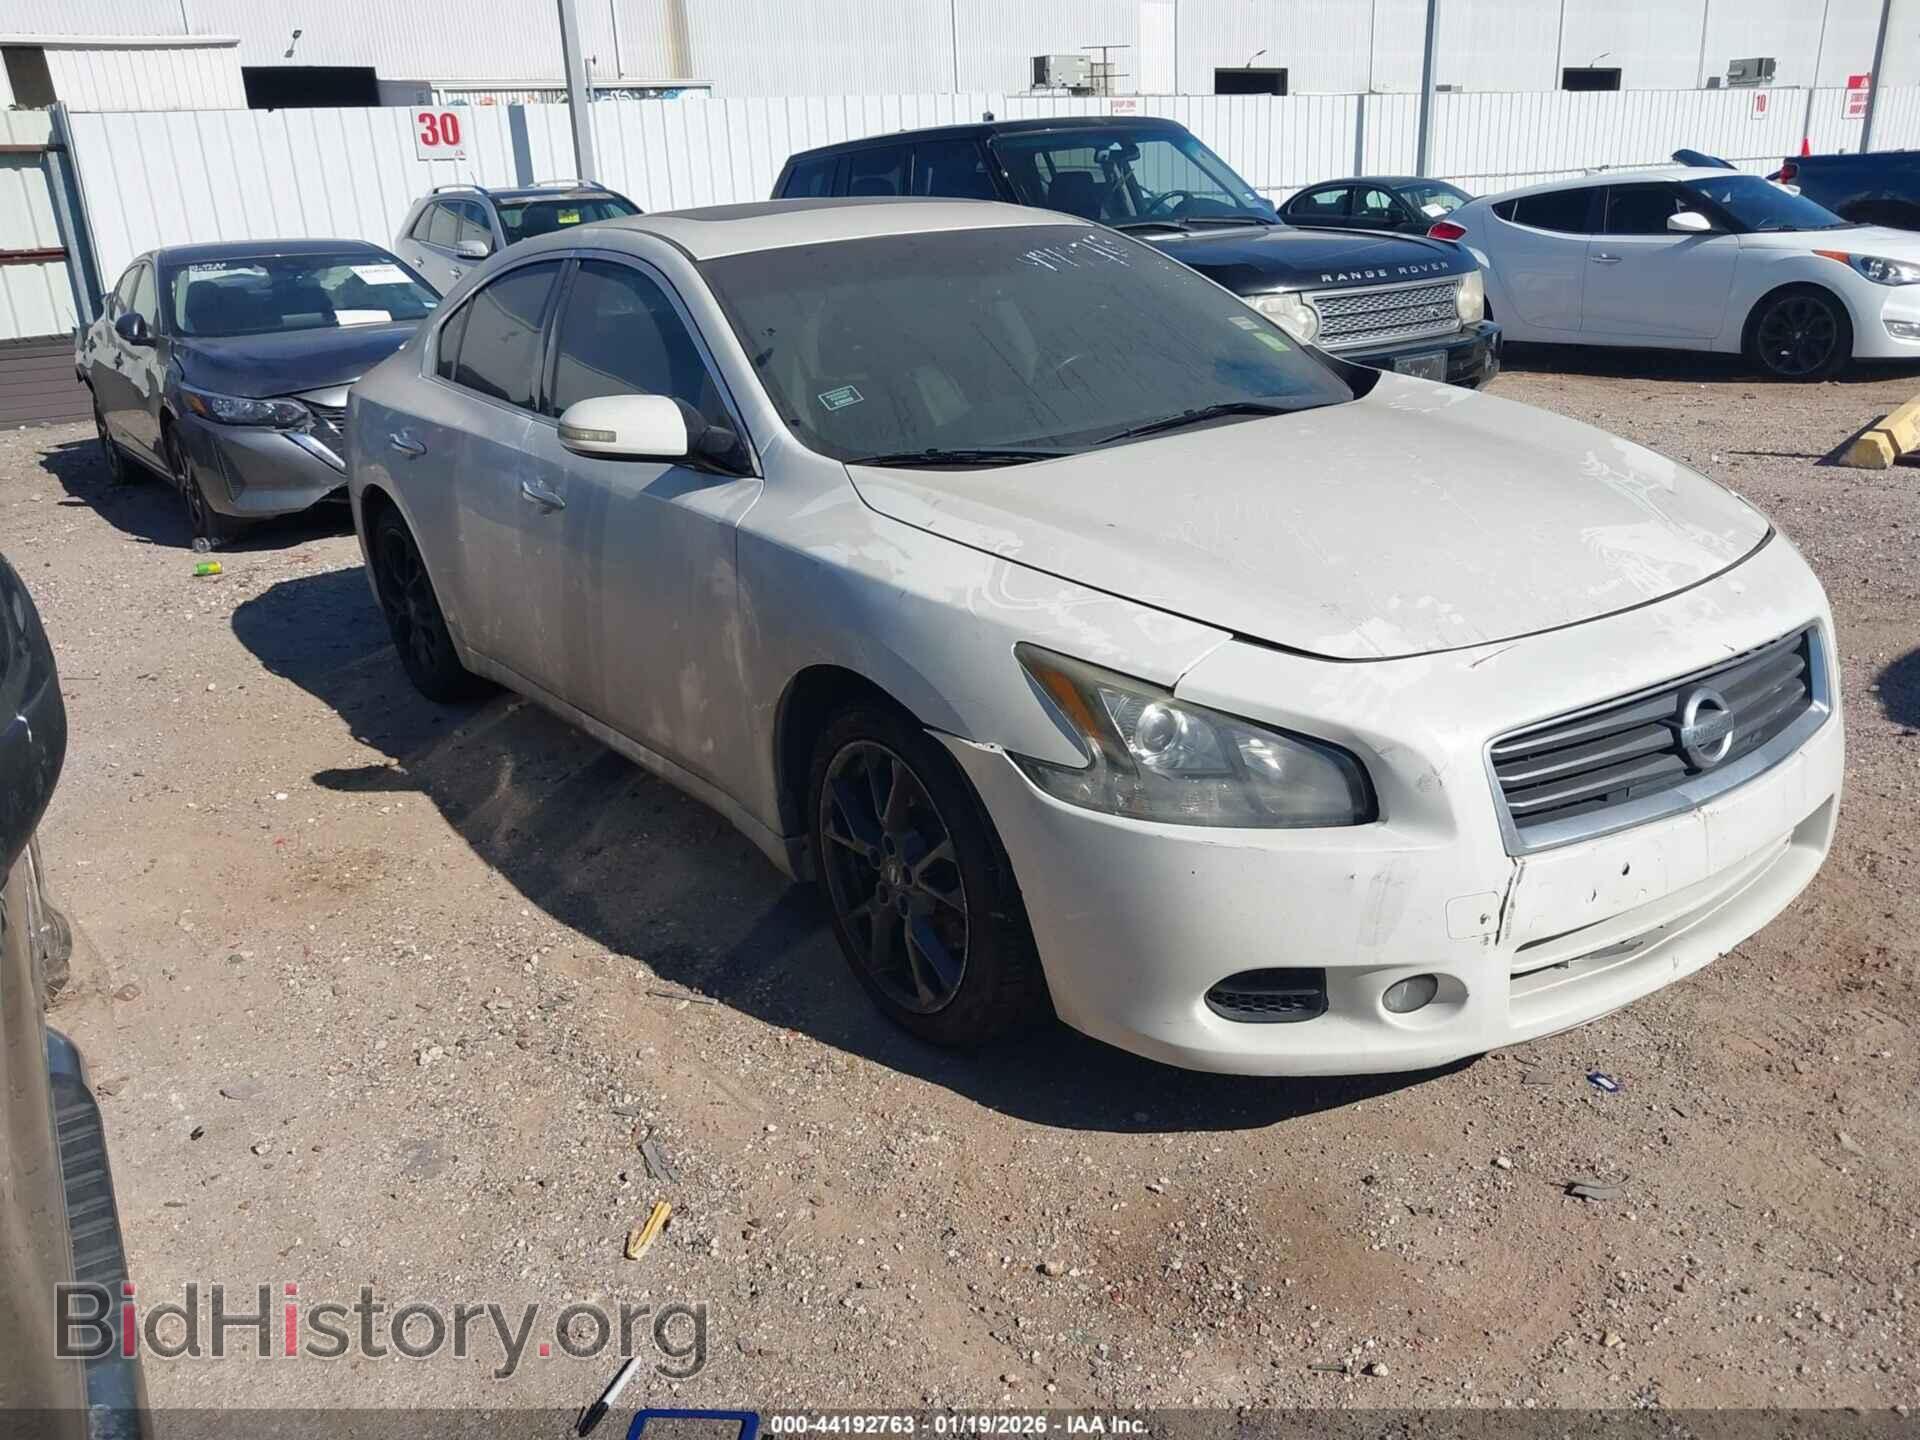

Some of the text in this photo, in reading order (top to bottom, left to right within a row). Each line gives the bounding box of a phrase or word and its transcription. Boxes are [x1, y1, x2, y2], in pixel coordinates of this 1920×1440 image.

[1756, 94, 1766, 112] 10
[418, 112, 460, 146] 30
[1321, 261, 1449, 283] RANGE ROVER
